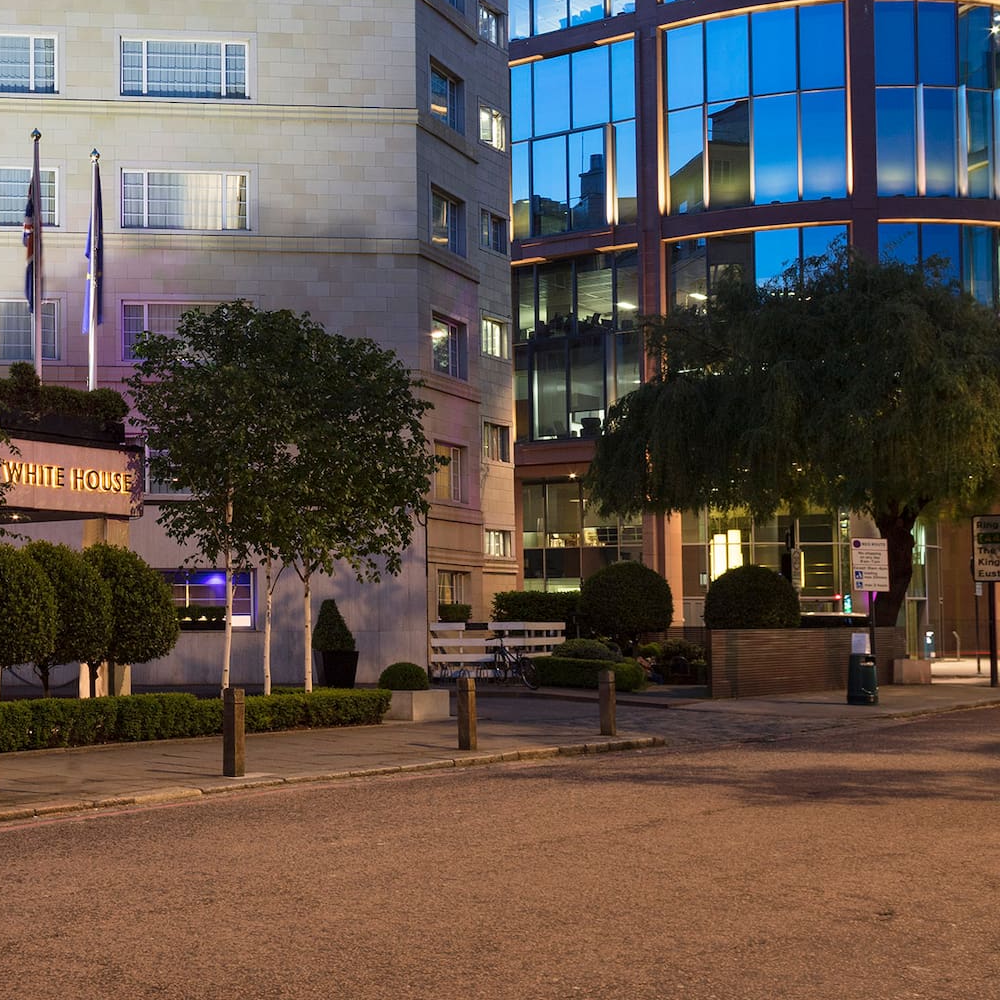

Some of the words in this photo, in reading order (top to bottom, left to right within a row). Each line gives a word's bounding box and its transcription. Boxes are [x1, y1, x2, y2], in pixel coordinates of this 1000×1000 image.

[1, 460, 65, 489] WHITE
[70, 467, 133, 495] HOUSE
[976, 521, 999, 530] Ring
